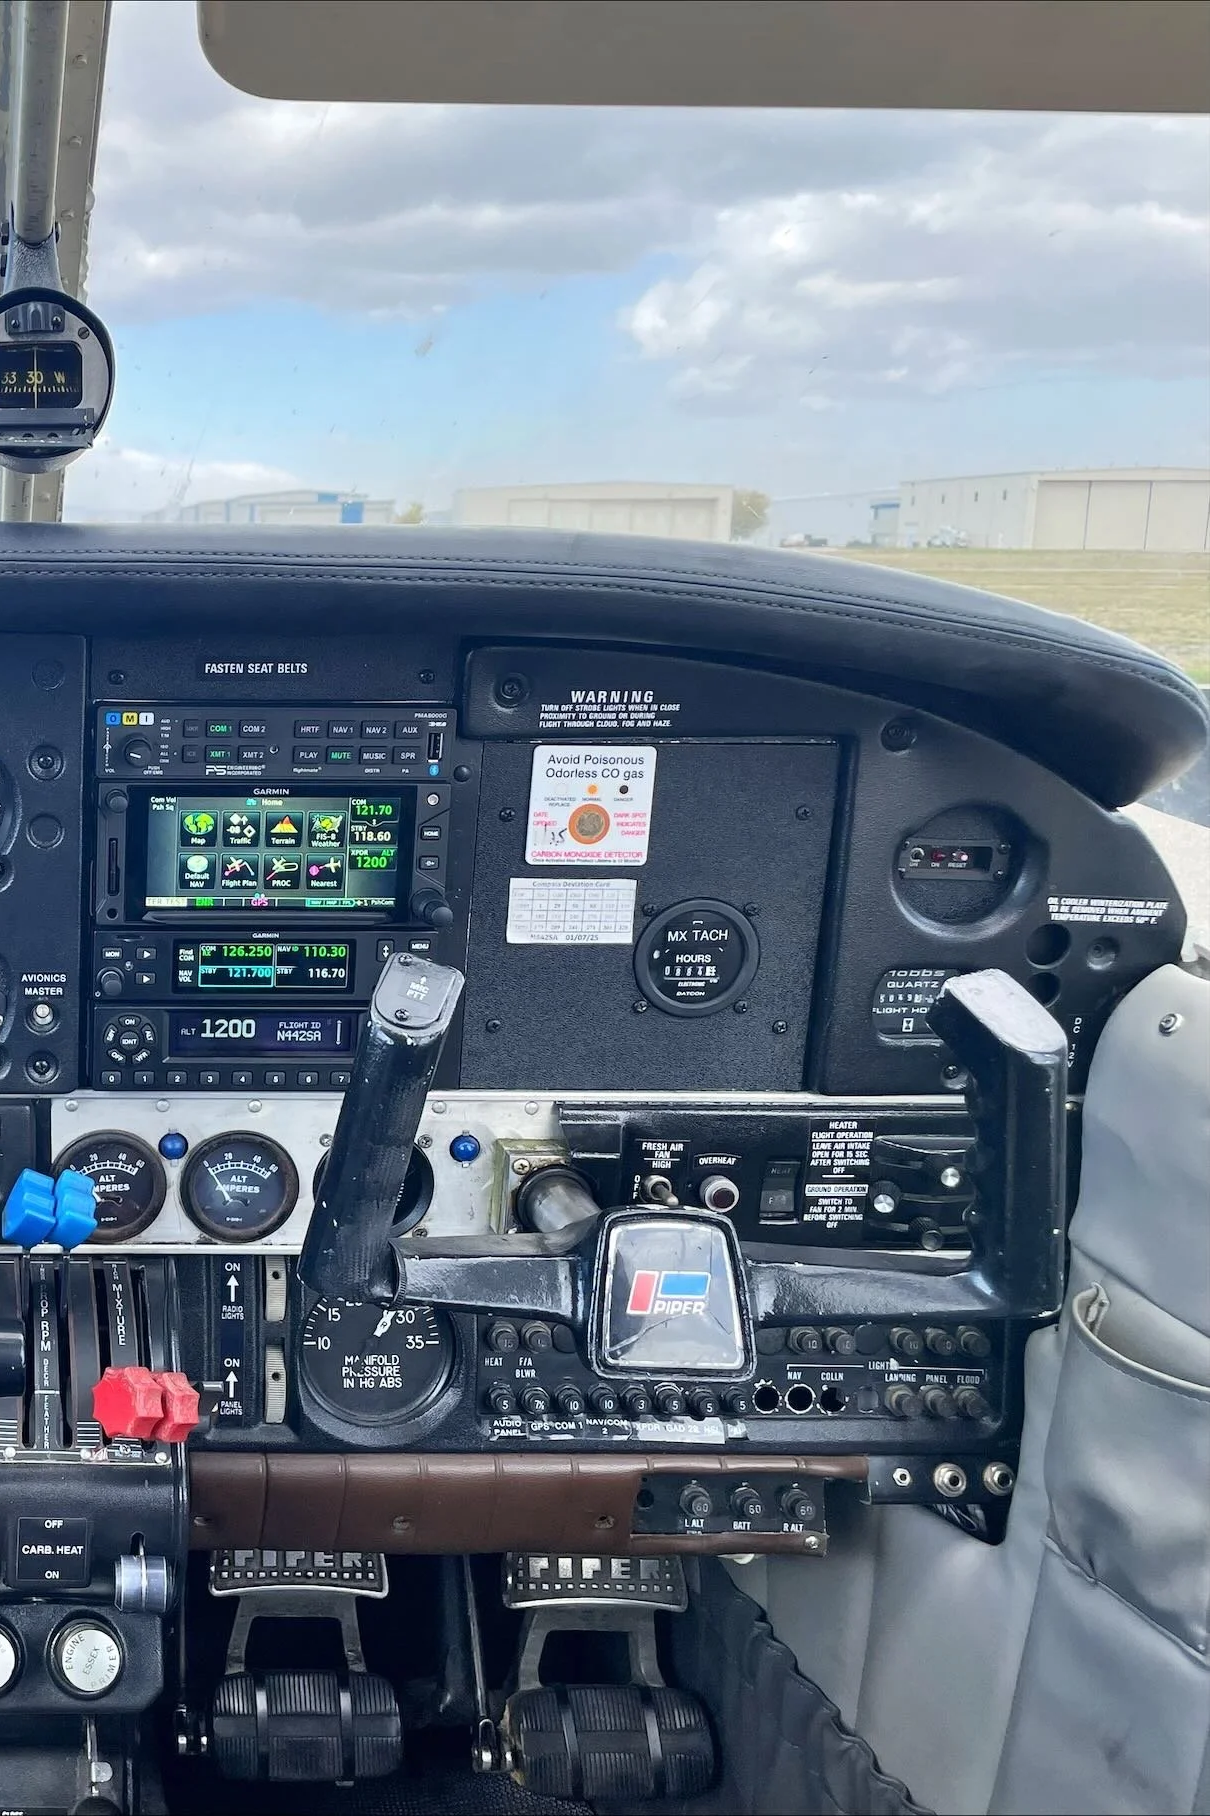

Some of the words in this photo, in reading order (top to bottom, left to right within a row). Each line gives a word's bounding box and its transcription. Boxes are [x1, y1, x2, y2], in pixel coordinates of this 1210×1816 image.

[1, 372, 16, 384] 33
[26, 371, 43, 384] 30
[54, 371, 65, 384] W
[205, 664, 244, 673] FASTEN
[248, 664, 273, 673] SEAT
[278, 663, 308, 673] BELTS
[571, 691, 654, 702] WARNING
[210, 725, 227, 733] COM
[243, 725, 259, 733] COM
[261, 725, 265, 733] 2
[366, 726, 380, 734] NAV
[403, 726, 418, 734] AUX
[210, 750, 225, 758] XMT
[242, 751, 258, 759] XMT
[300, 751, 318, 759] PLAY
[363, 752, 386, 760] MUSIC
[548, 755, 580, 764] Avoid
[584, 755, 644, 764] Poisonous
[546, 768, 597, 778] Odorless
[602, 769, 619, 778] CO
[624, 770, 644, 780] gas
[355, 805, 392, 815] 121.70
[354, 831, 390, 841] 118.60
[356, 857, 387, 867] 1200
[222, 880, 239, 888] Flight
[668, 931, 687, 941] MX
[692, 930, 728, 941] TACH
[223, 946, 272, 957] 126.250
[304, 946, 346, 957] 110.30
[676, 955, 711, 963] HOURS
[228, 968, 271, 978] 121.700
[309, 969, 345, 978] 116.70
[22, 974, 66, 982] AVIONICS
[201, 1019, 255, 1038] 1200
[277, 1031, 321, 1041] N442SA
[642, 1143, 664, 1152] FRESH
[668, 1143, 683, 1151] AIR
[699, 1157, 736, 1166] OVERHEAT
[216, 1185, 259, 1193] AMPERES
[225, 1263, 240, 1271] ON
[112, 1284, 125, 1346] MIXTURE
[222, 1312, 244, 1320] LIGHTS
[345, 1356, 399, 1366] MANIFOLD
[485, 1358, 503, 1366] HEAT
[343, 1378, 354, 1388] IN
[360, 1378, 375, 1388] HG
[379, 1378, 402, 1388] ABS
[555, 1422, 576, 1430] COM
[733, 1522, 751, 1530] BATT
[22, 1546, 54, 1554] CARB.
[57, 1546, 83, 1554] HEAT
